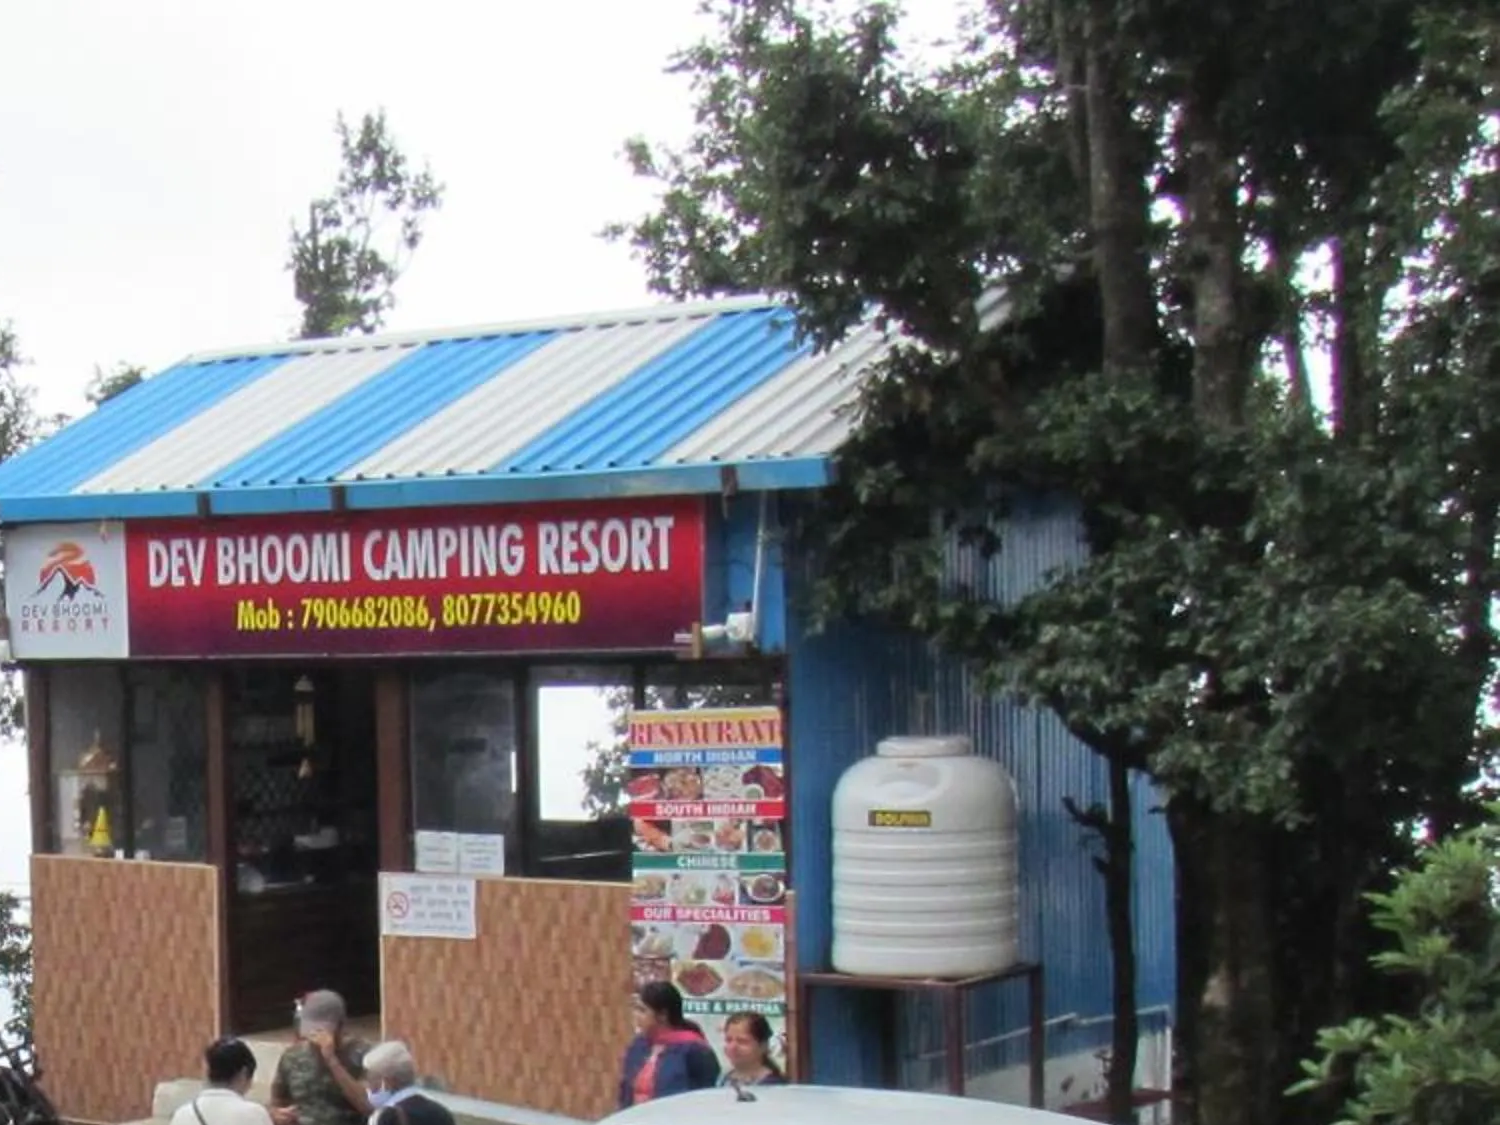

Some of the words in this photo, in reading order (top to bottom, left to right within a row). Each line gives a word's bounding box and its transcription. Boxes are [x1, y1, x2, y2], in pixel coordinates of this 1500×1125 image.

[147, 537, 207, 588] DEV
[216, 531, 350, 586] BHOOMI
[362, 523, 525, 582] CAMPING
[537, 515, 675, 576] RESORT
[21, 604, 49, 618] DEV
[51, 602, 108, 617] BHOOMI
[237, 597, 281, 630] Mob
[299, 594, 436, 633] 7906682086,
[441, 590, 581, 627] 8077354960
[21, 618, 108, 632] RESORT
[631, 719, 778, 745] RESTAURANT
[653, 751, 703, 763] NORTH
[706, 750, 758, 762] INDIAN
[656, 803, 704, 816] SOUTH
[707, 802, 758, 815] INDIAN
[676, 856, 739, 869] CHINESE
[643, 907, 672, 920] OUR
[675, 907, 772, 922] SPECIALITIES
